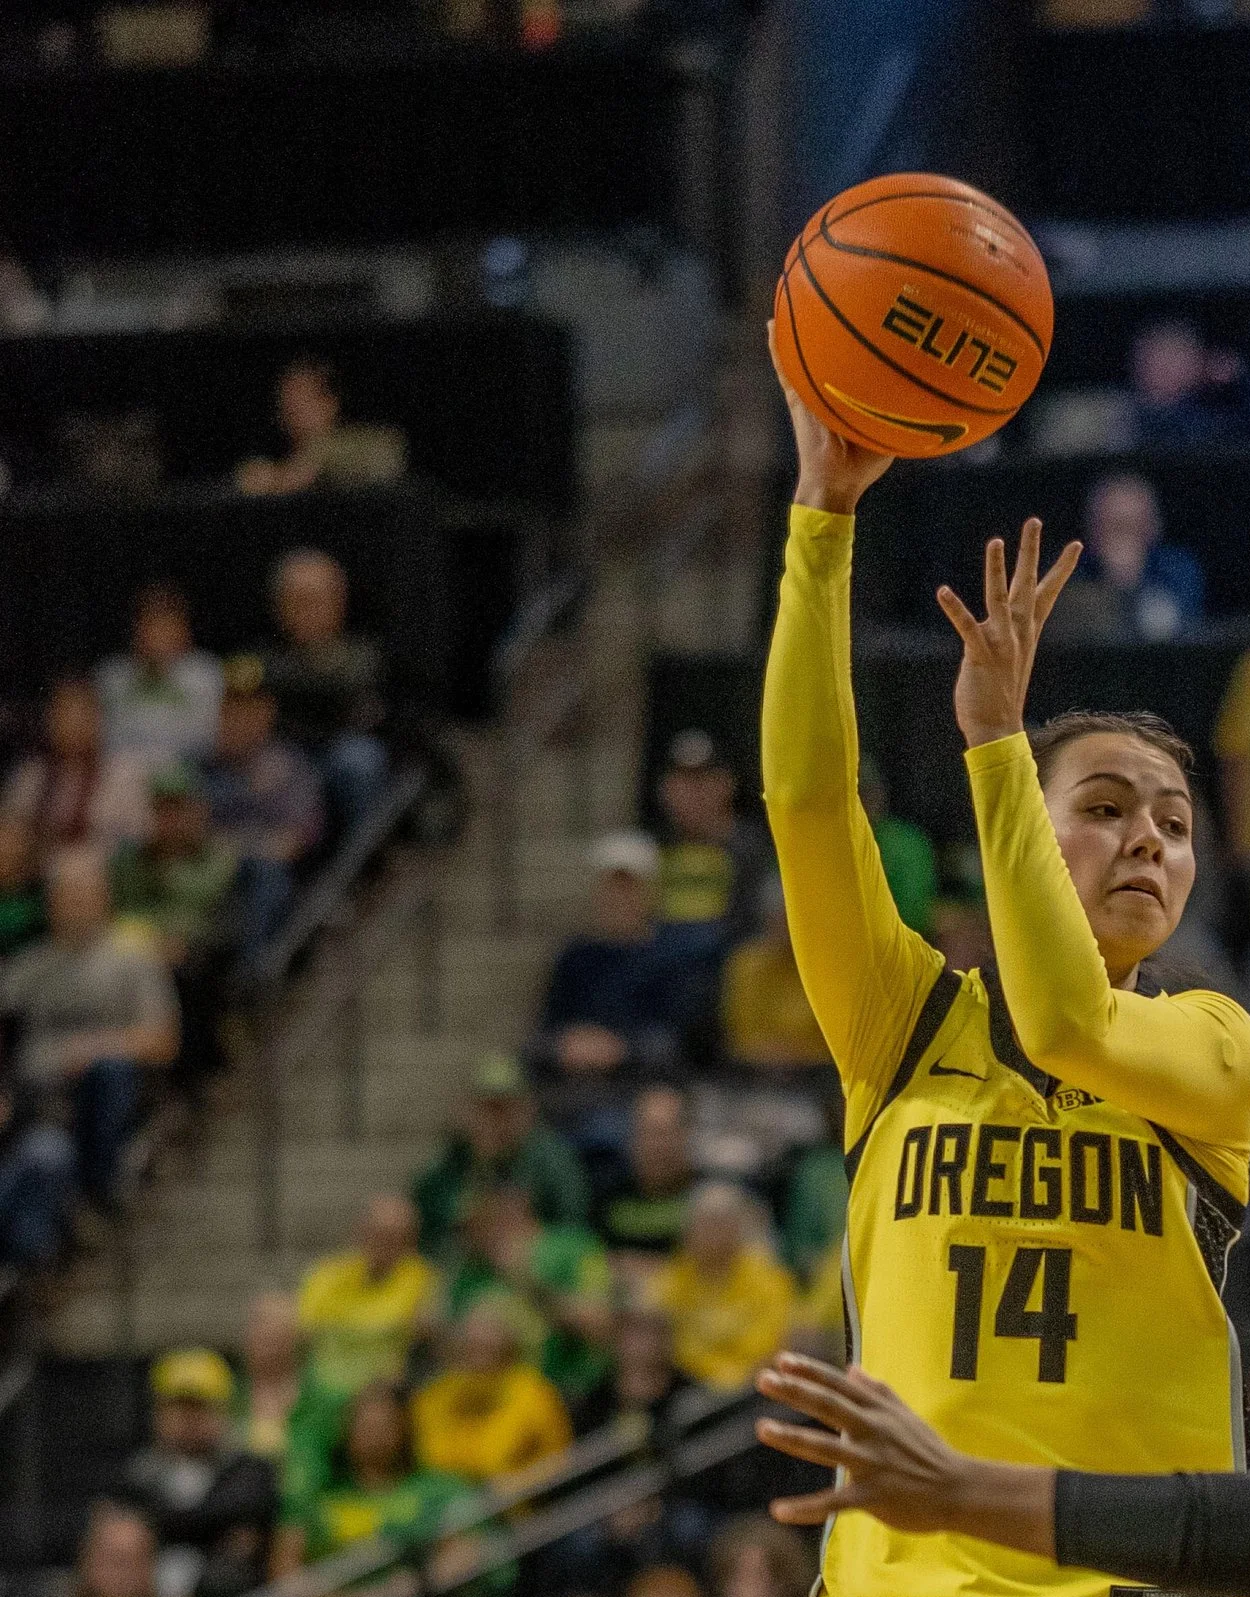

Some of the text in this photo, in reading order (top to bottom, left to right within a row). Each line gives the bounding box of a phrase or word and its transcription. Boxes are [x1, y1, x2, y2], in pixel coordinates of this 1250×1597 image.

[881, 294, 1018, 394] ELITE
[894, 1122, 1163, 1238] OREGON
[948, 1244, 1078, 1384] 14
